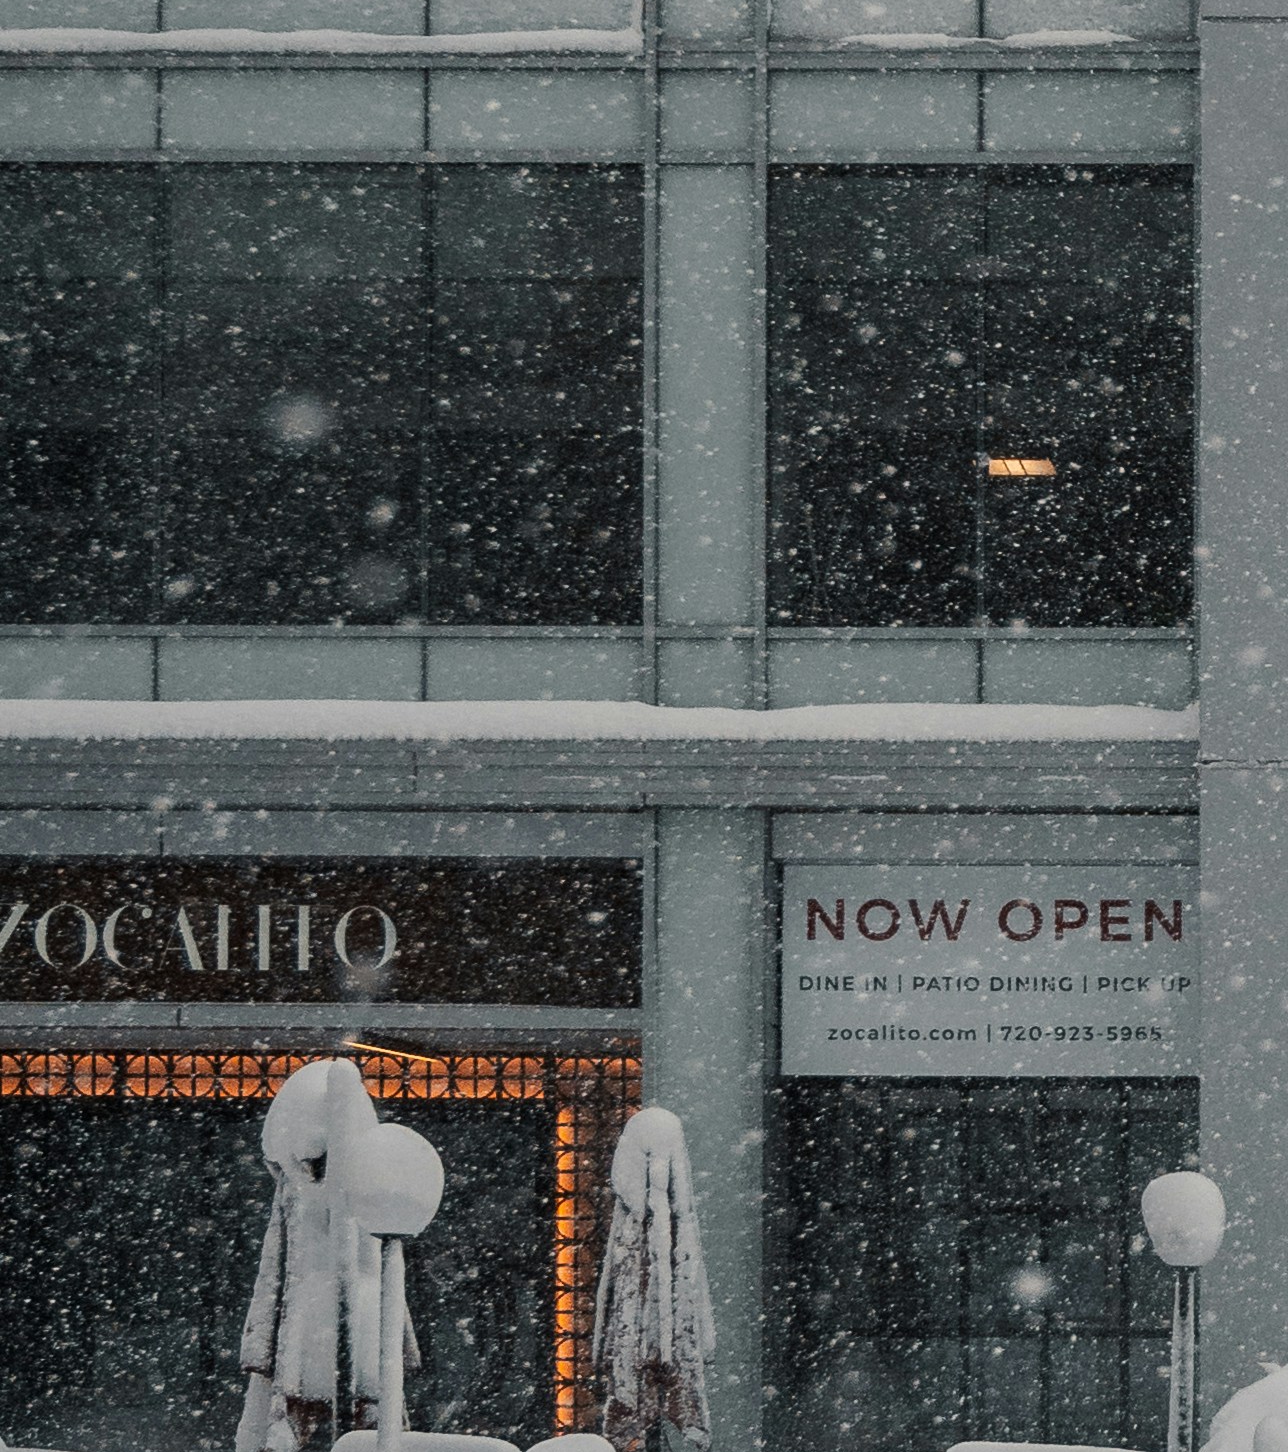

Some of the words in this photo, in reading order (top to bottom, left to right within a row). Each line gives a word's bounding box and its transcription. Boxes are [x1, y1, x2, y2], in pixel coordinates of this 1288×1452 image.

[805, 897, 972, 942] NOW
[997, 897, 1184, 943] OPEN
[798, 975, 856, 992] DINE
[864, 975, 889, 992] IN
[912, 975, 981, 992] PATIO
[989, 975, 1074, 993] DINING
[1097, 975, 1152, 993] PICK
[1160, 976, 1192, 993] UP
[826, 1024, 978, 1042] zocalito.com
[999, 1024, 1164, 1043] 720-923-5965
